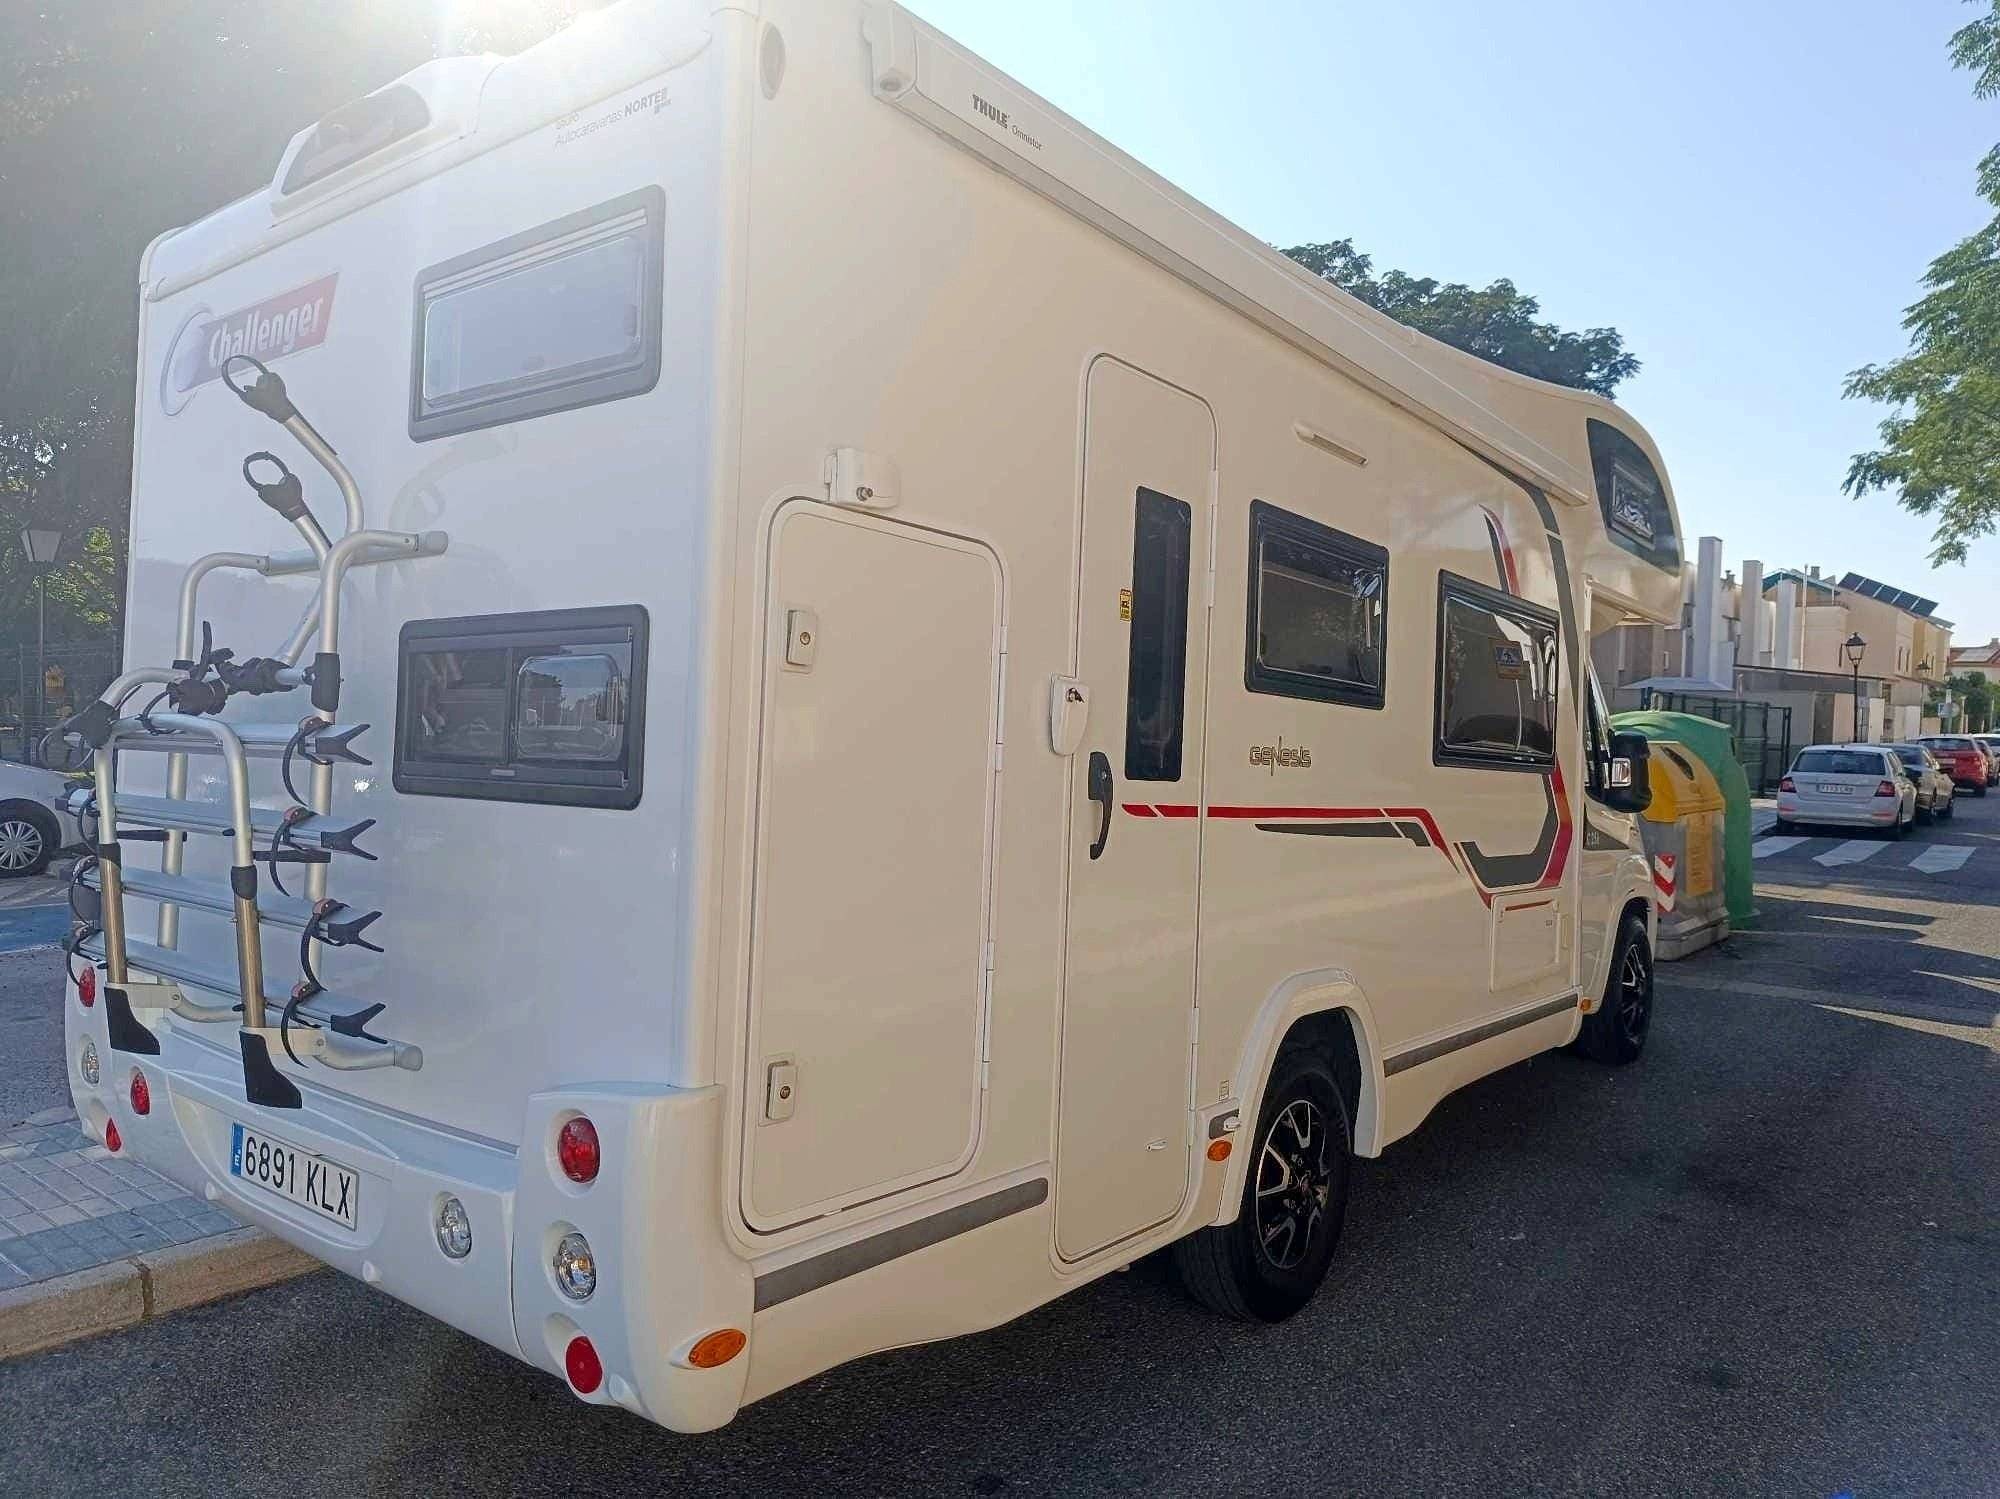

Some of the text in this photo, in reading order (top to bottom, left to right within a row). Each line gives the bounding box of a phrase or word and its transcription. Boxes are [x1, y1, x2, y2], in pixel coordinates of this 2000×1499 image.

[972, 93, 1008, 129] THULE
[208, 297, 324, 369] Challenger
[245, 1136, 351, 1221] 6891 KLX
